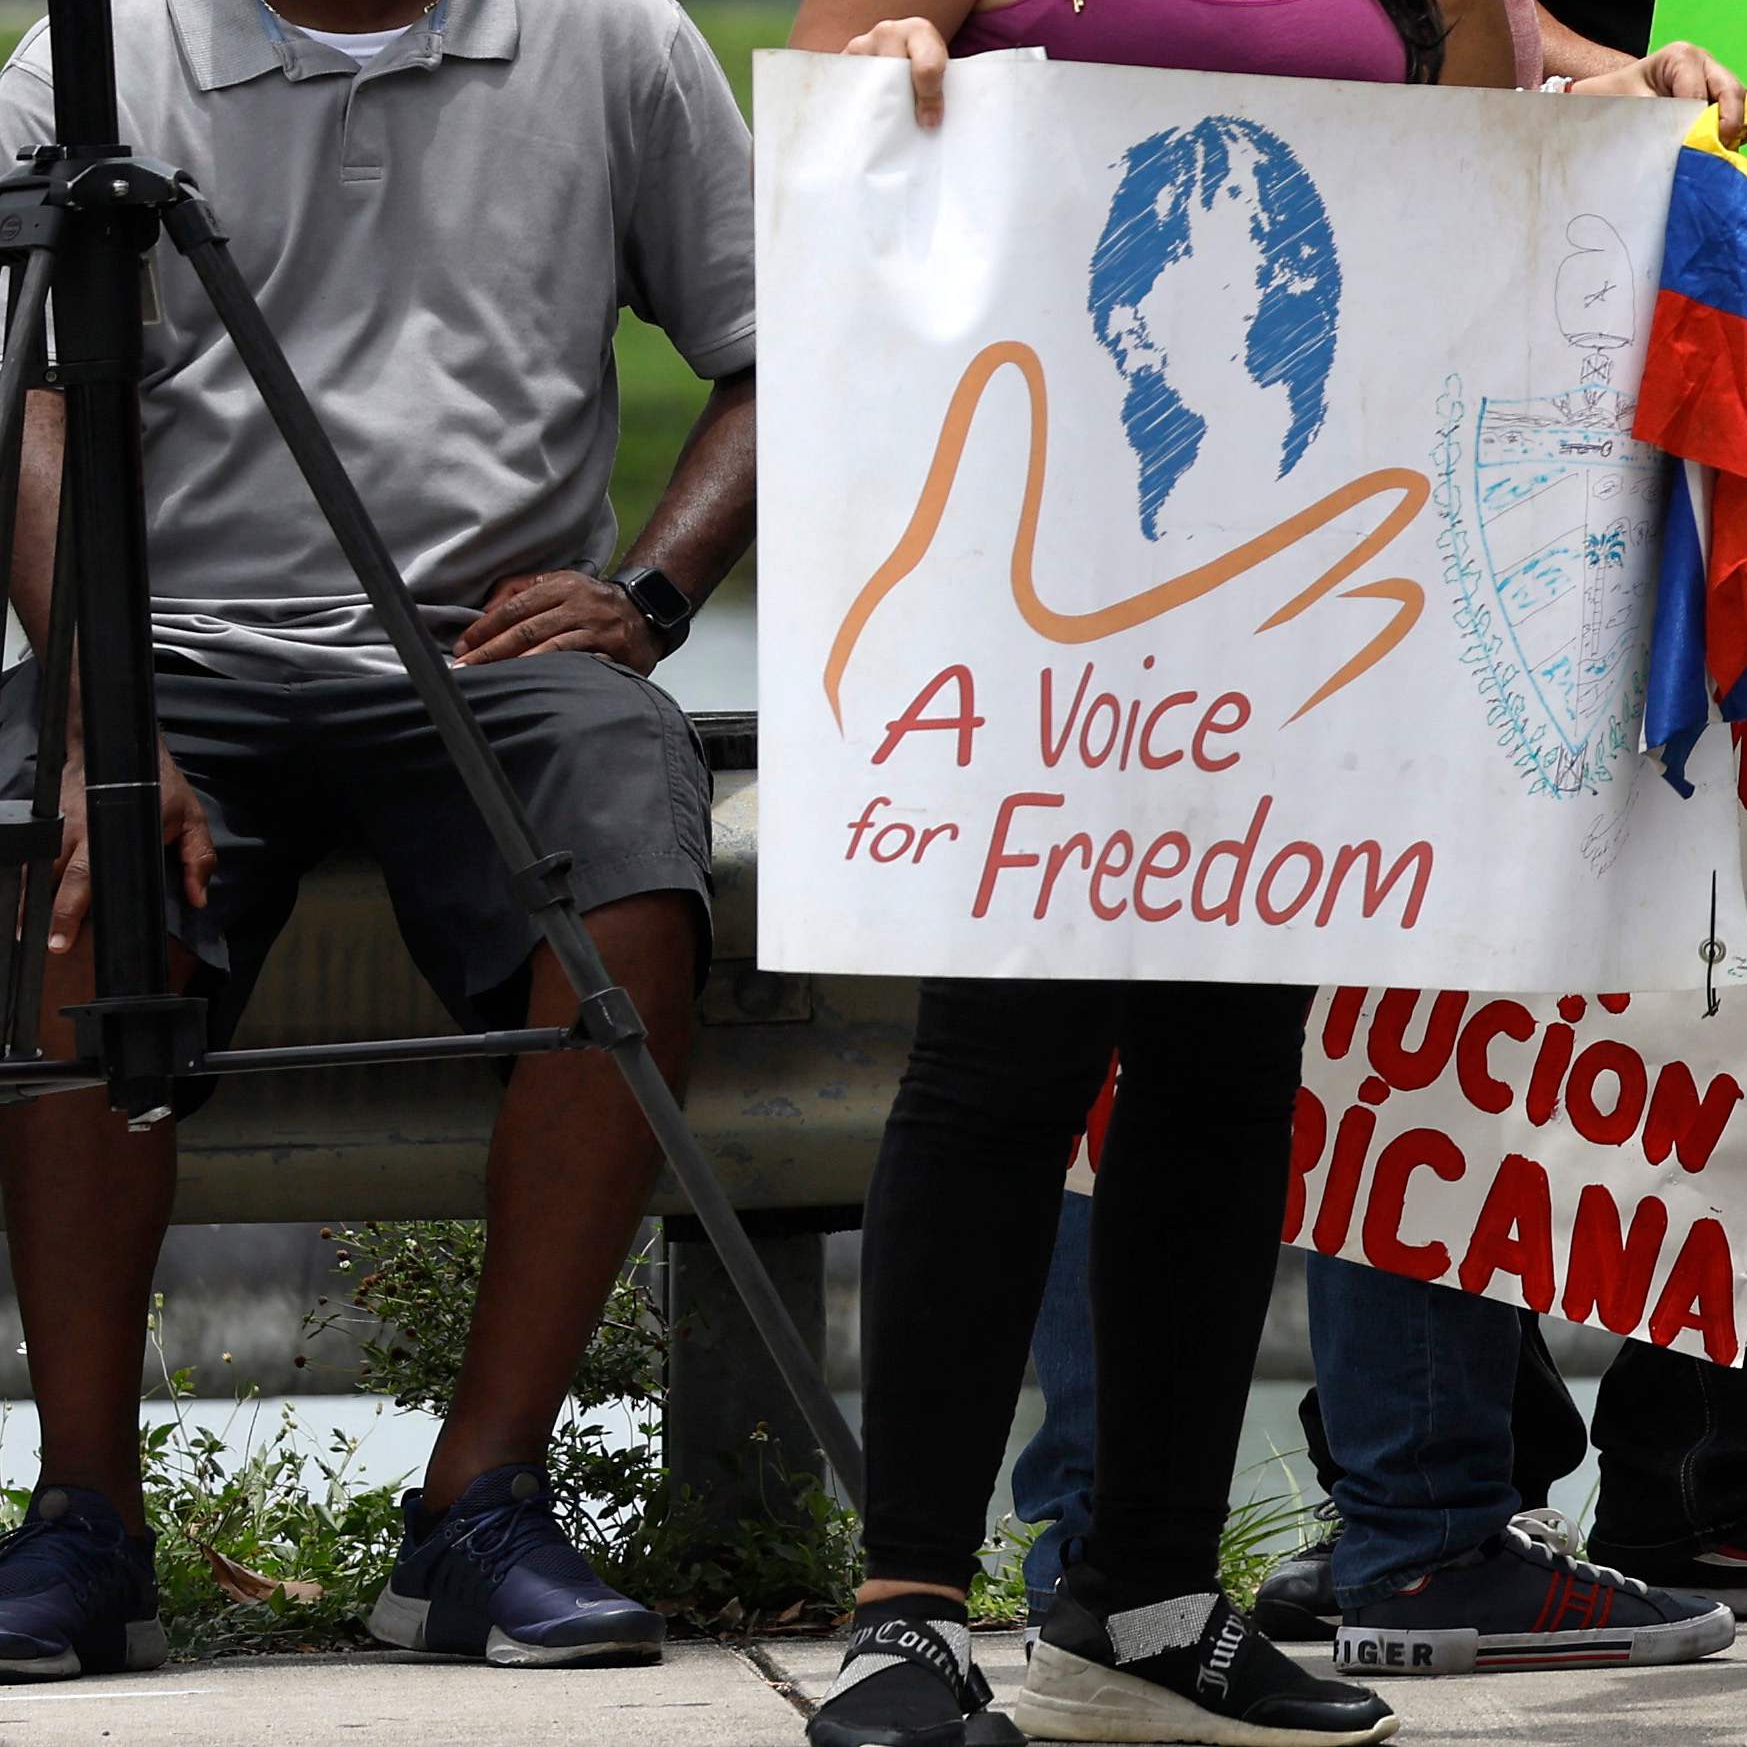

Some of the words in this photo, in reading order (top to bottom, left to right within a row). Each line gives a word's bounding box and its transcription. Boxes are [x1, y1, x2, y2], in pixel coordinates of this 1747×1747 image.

[872, 664, 985, 767] A
[1040, 657, 1252, 773] Voice
[846, 796, 959, 863] for
[972, 792, 1434, 930] Freedom
[1195, 1613, 1247, 1700] Juicy
